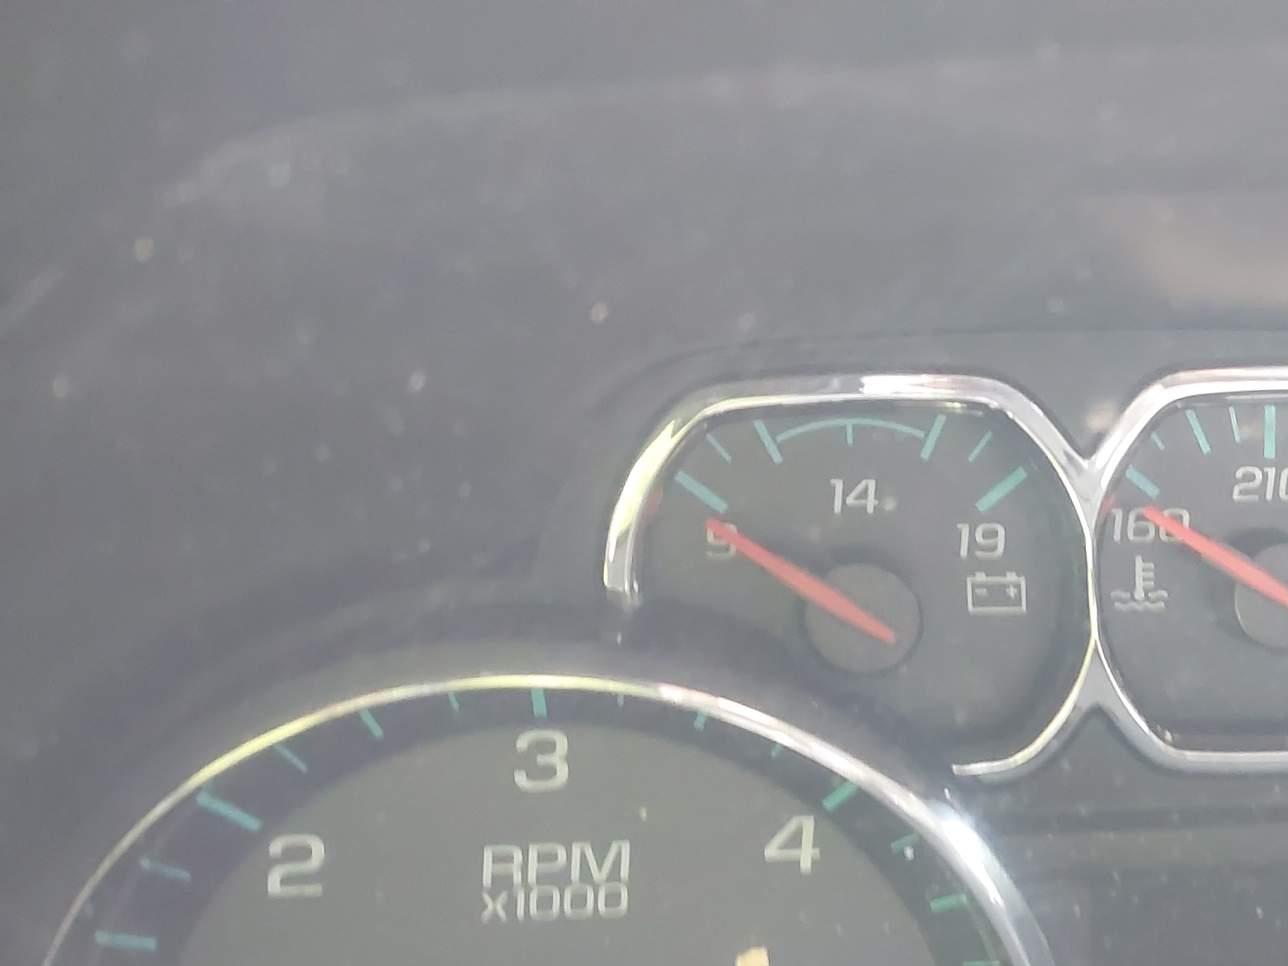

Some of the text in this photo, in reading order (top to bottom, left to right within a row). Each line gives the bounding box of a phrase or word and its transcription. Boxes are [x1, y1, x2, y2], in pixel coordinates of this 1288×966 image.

[830, 478, 878, 514] 14
[957, 522, 1006, 559] 19
[1111, 507, 1190, 543] 160
[514, 729, 569, 792] 3
[267, 834, 326, 898] 2
[481, 839, 631, 889] RPM
[764, 815, 820, 874] 4
[480, 881, 629, 924] x1000
